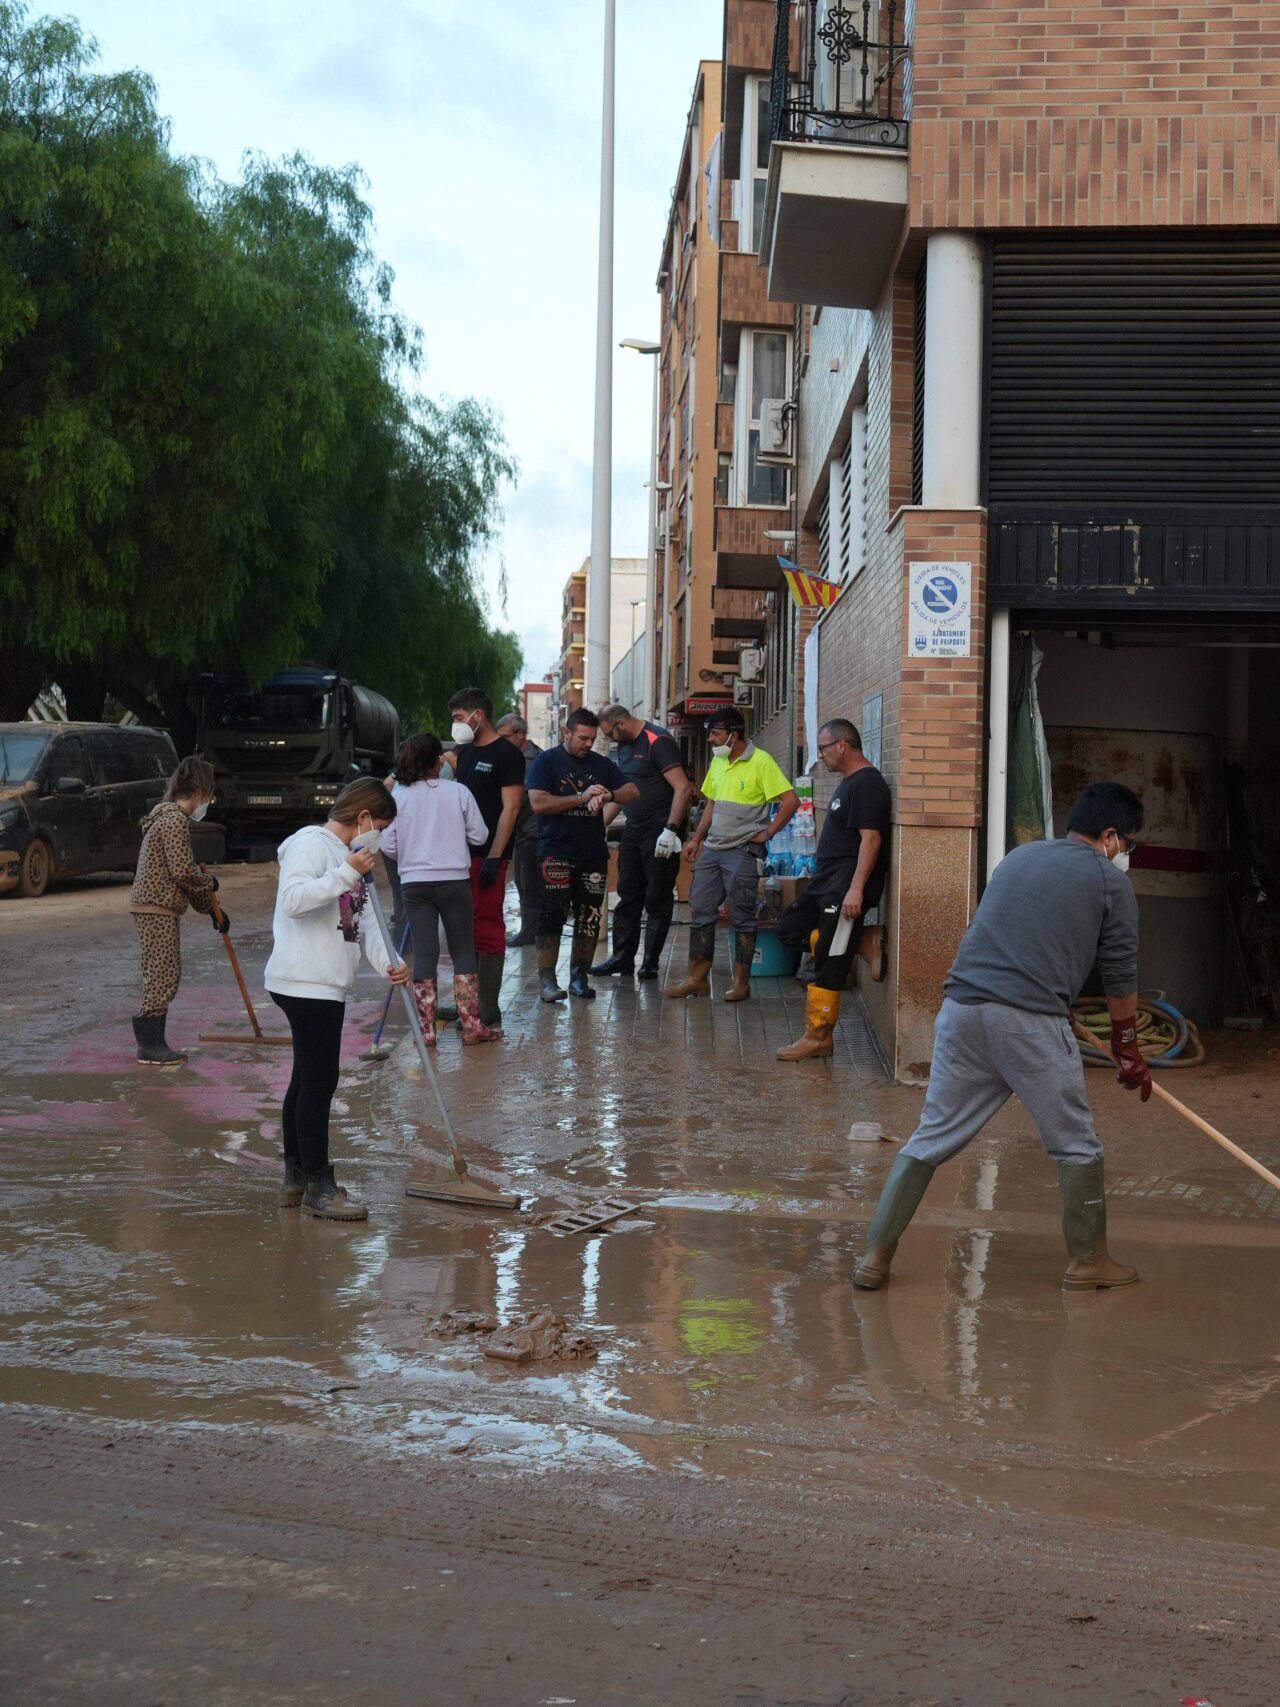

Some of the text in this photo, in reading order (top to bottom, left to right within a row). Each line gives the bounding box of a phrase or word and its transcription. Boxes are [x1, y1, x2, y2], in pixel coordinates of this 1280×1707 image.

[911, 601, 928, 620] SALIDA
[932, 638, 966, 646] DE PAIPORTA
